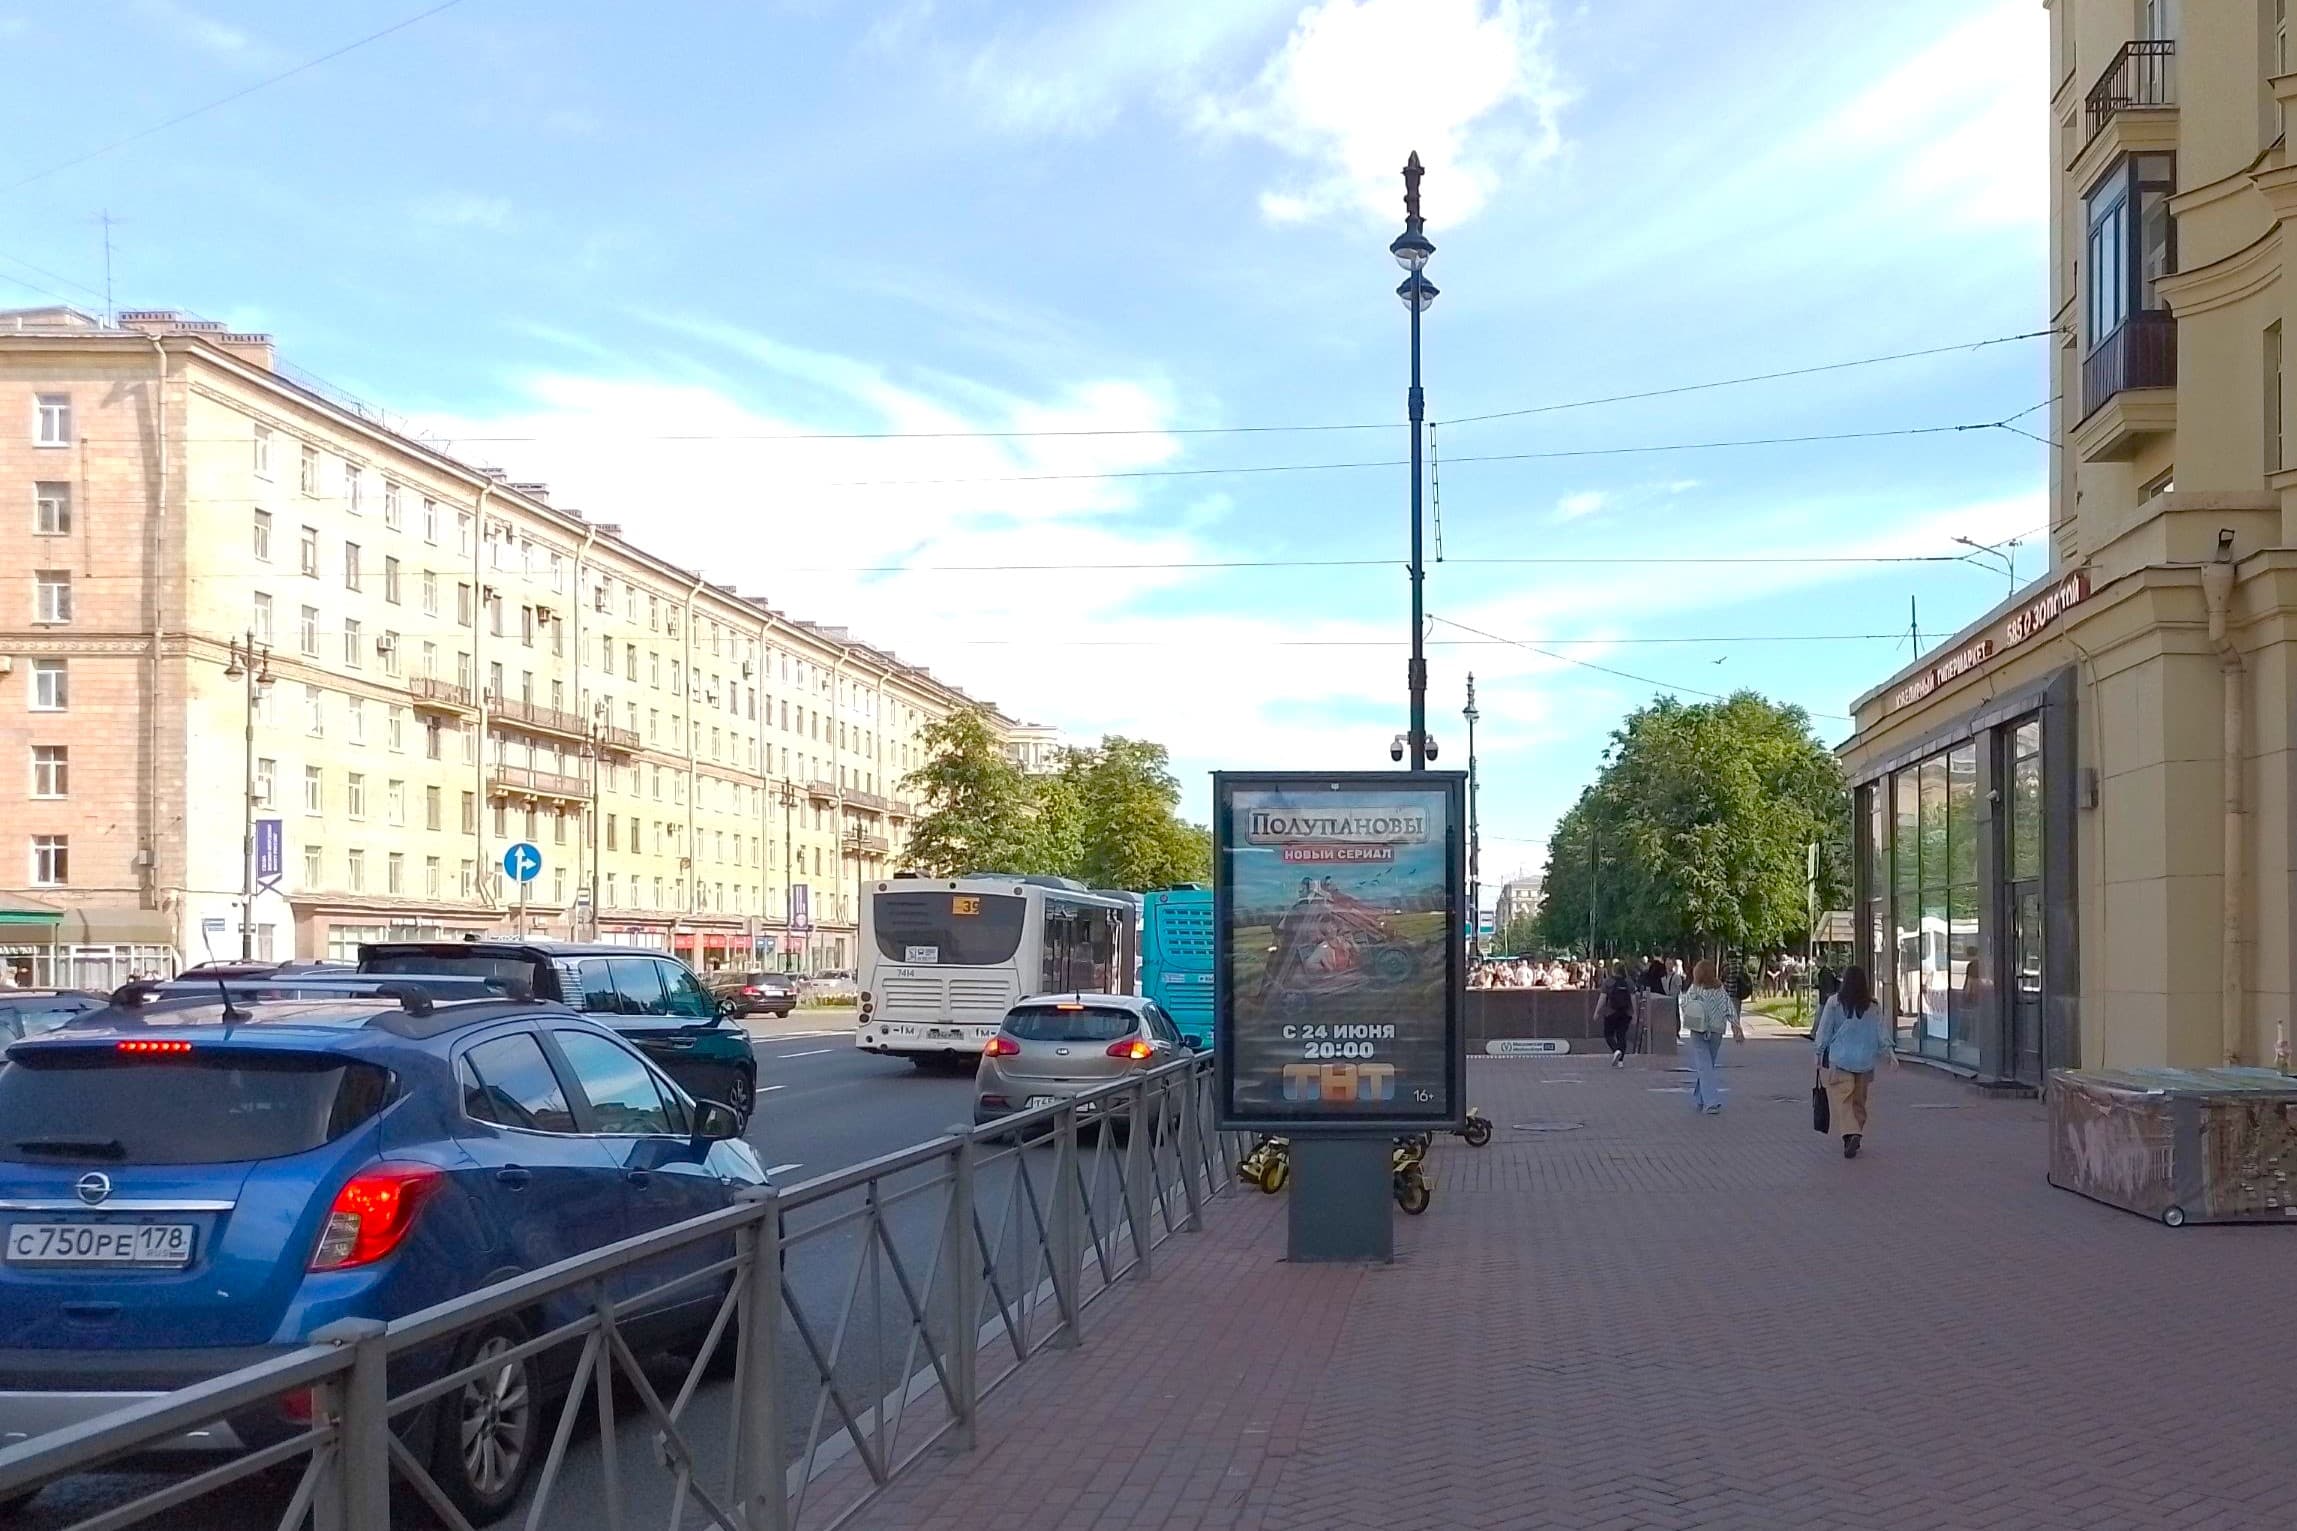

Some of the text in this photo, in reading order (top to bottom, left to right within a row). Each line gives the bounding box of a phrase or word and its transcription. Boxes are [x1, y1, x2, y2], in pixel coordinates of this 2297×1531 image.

[2006, 615, 2023, 645] 585
[1937, 640, 1987, 686] ГИПЕРМАРКЕТ
[1283, 847, 1392, 860] НОВЫЙ СЕРИАЛ
[1282, 1024, 1396, 1039] С 24 ИЮНЯ
[1304, 1041, 1375, 1059] 20:00
[1282, 1062, 1396, 1101] ТНТ
[1412, 1089, 1435, 1103] 16+
[17, 1226, 184, 1257] С750РЕ 178
